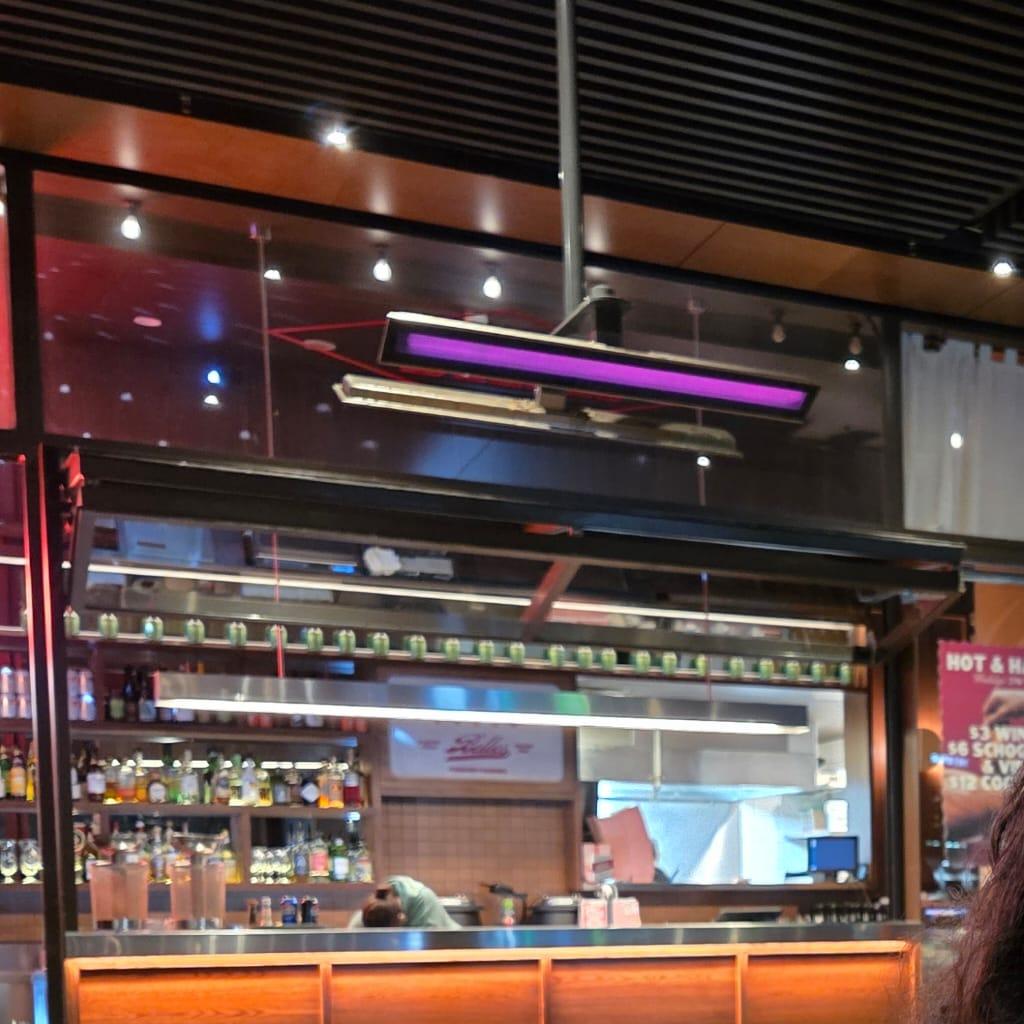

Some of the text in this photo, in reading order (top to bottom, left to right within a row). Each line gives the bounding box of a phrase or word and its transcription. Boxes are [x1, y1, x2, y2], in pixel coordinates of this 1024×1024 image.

[946, 653, 986, 673] HOT
[990, 656, 1004, 674] &
[981, 760, 994, 774] &
